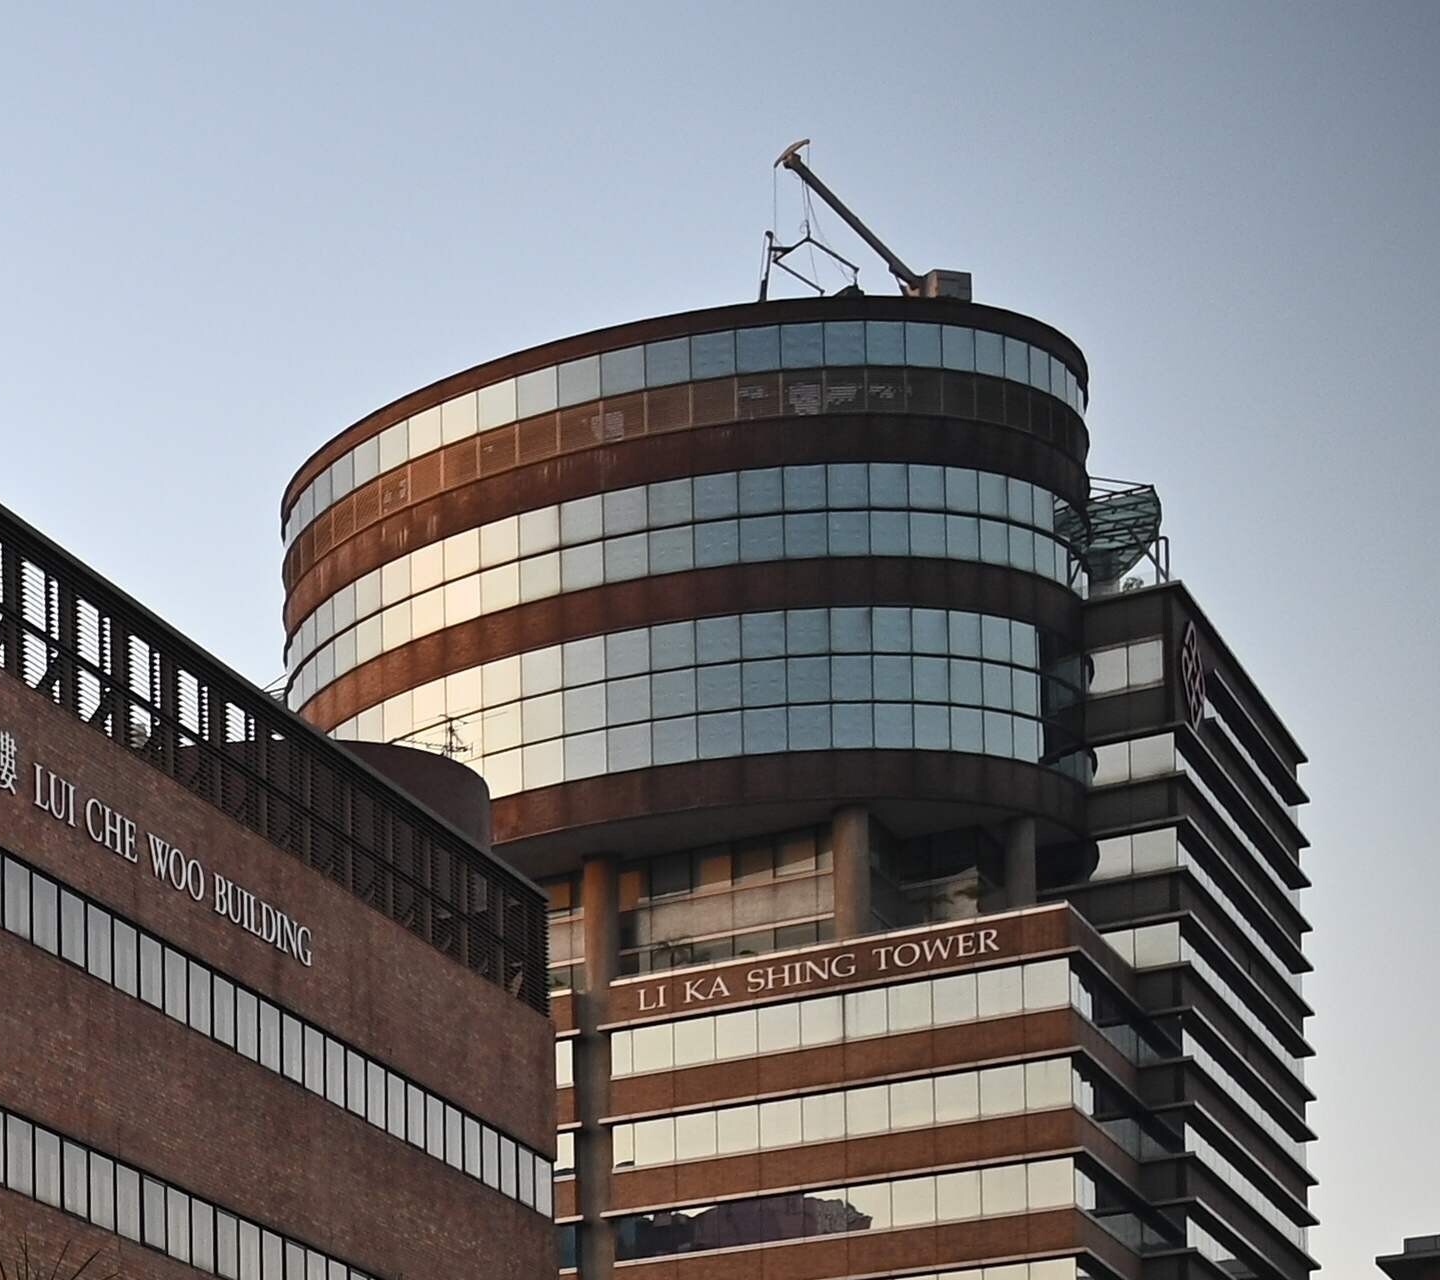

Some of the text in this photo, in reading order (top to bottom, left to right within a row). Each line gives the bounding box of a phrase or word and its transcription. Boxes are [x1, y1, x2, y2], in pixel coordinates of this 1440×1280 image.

[33, 764, 76, 828] LUI
[86, 798, 138, 863] CHE
[148, 832, 204, 901] WOO
[214, 872, 312, 967] BUILDING
[638, 928, 1000, 1011] LI KA SHING TOWER
